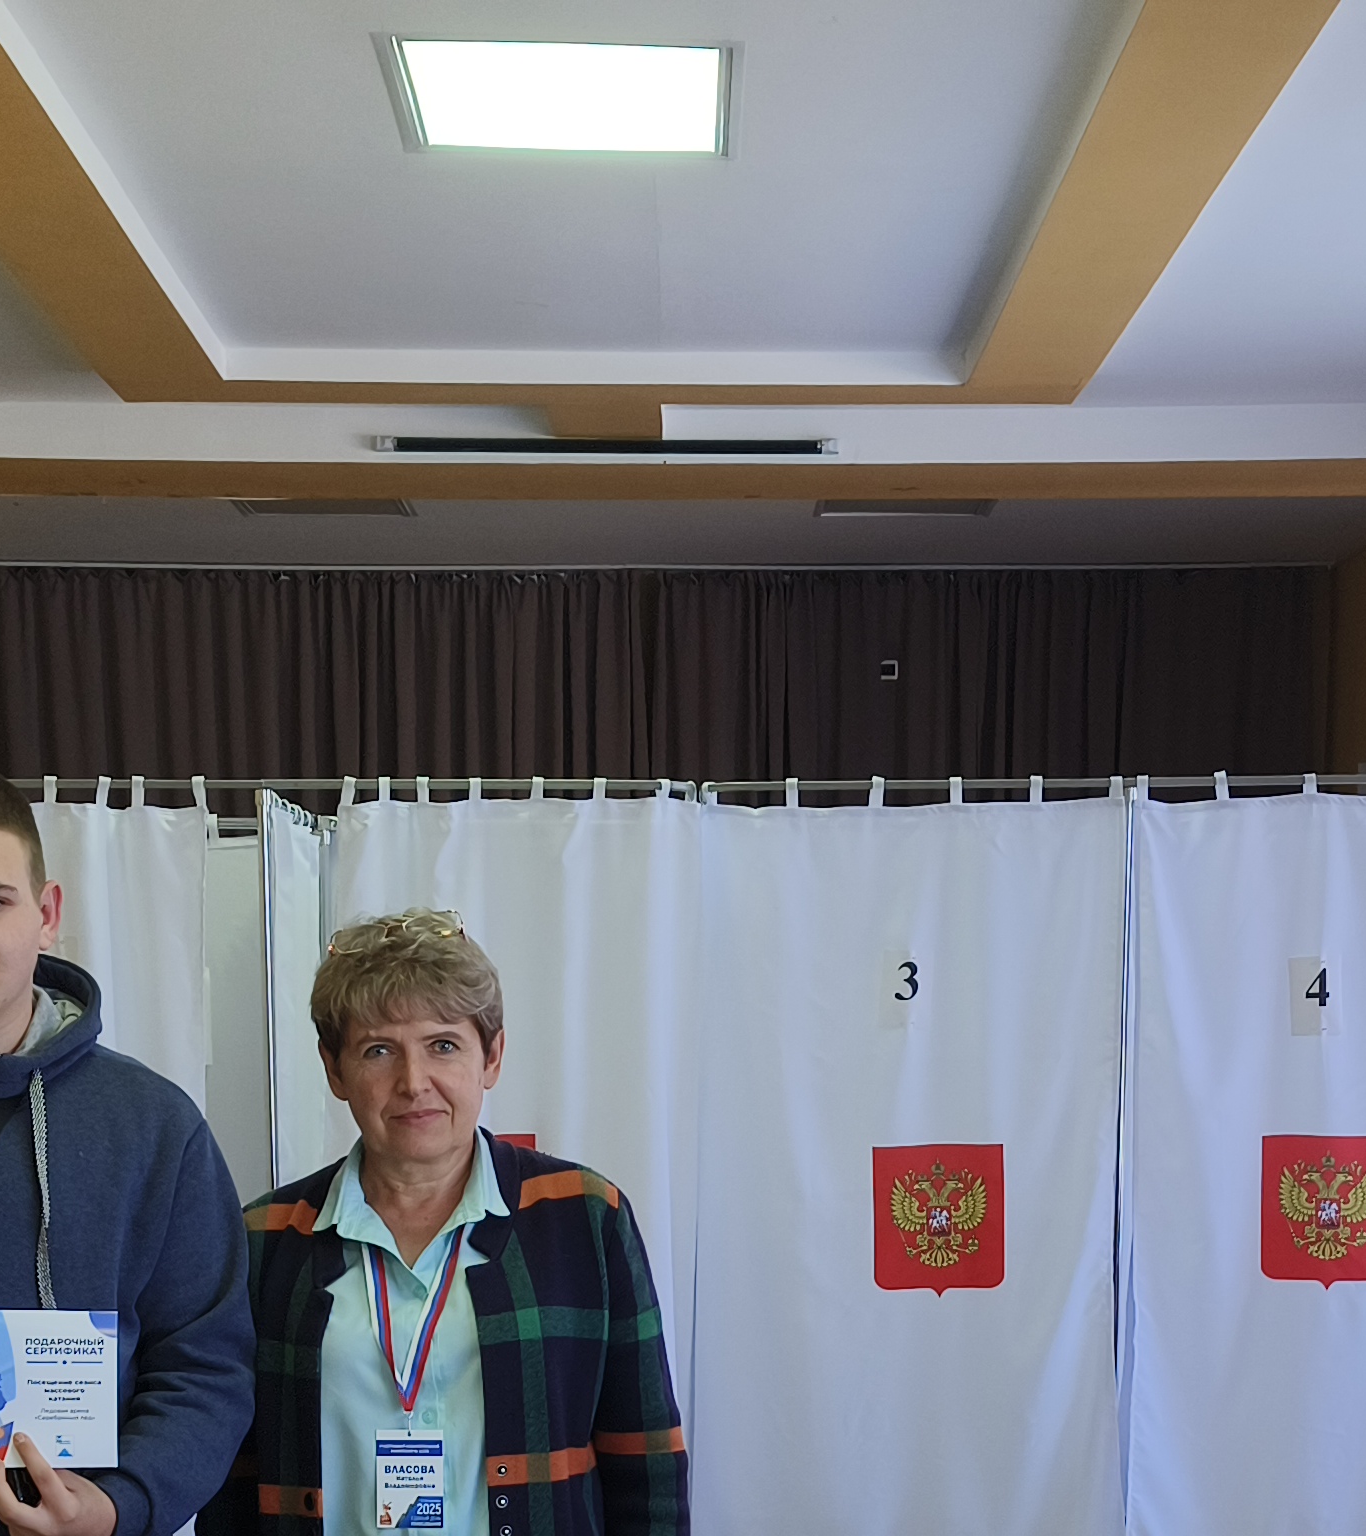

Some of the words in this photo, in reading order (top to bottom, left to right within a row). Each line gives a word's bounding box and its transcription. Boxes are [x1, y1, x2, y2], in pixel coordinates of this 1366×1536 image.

[894, 961, 919, 1001] 3
[1305, 967, 1330, 1007] 4
[25, 1336, 105, 1346] ПОДАРОЧНЫЙ
[25, 1346, 105, 1356] СЕРТИФИКАТ
[384, 1465, 435, 1474] ВЛАСОВА
[416, 1503, 442, 1515] 2025
